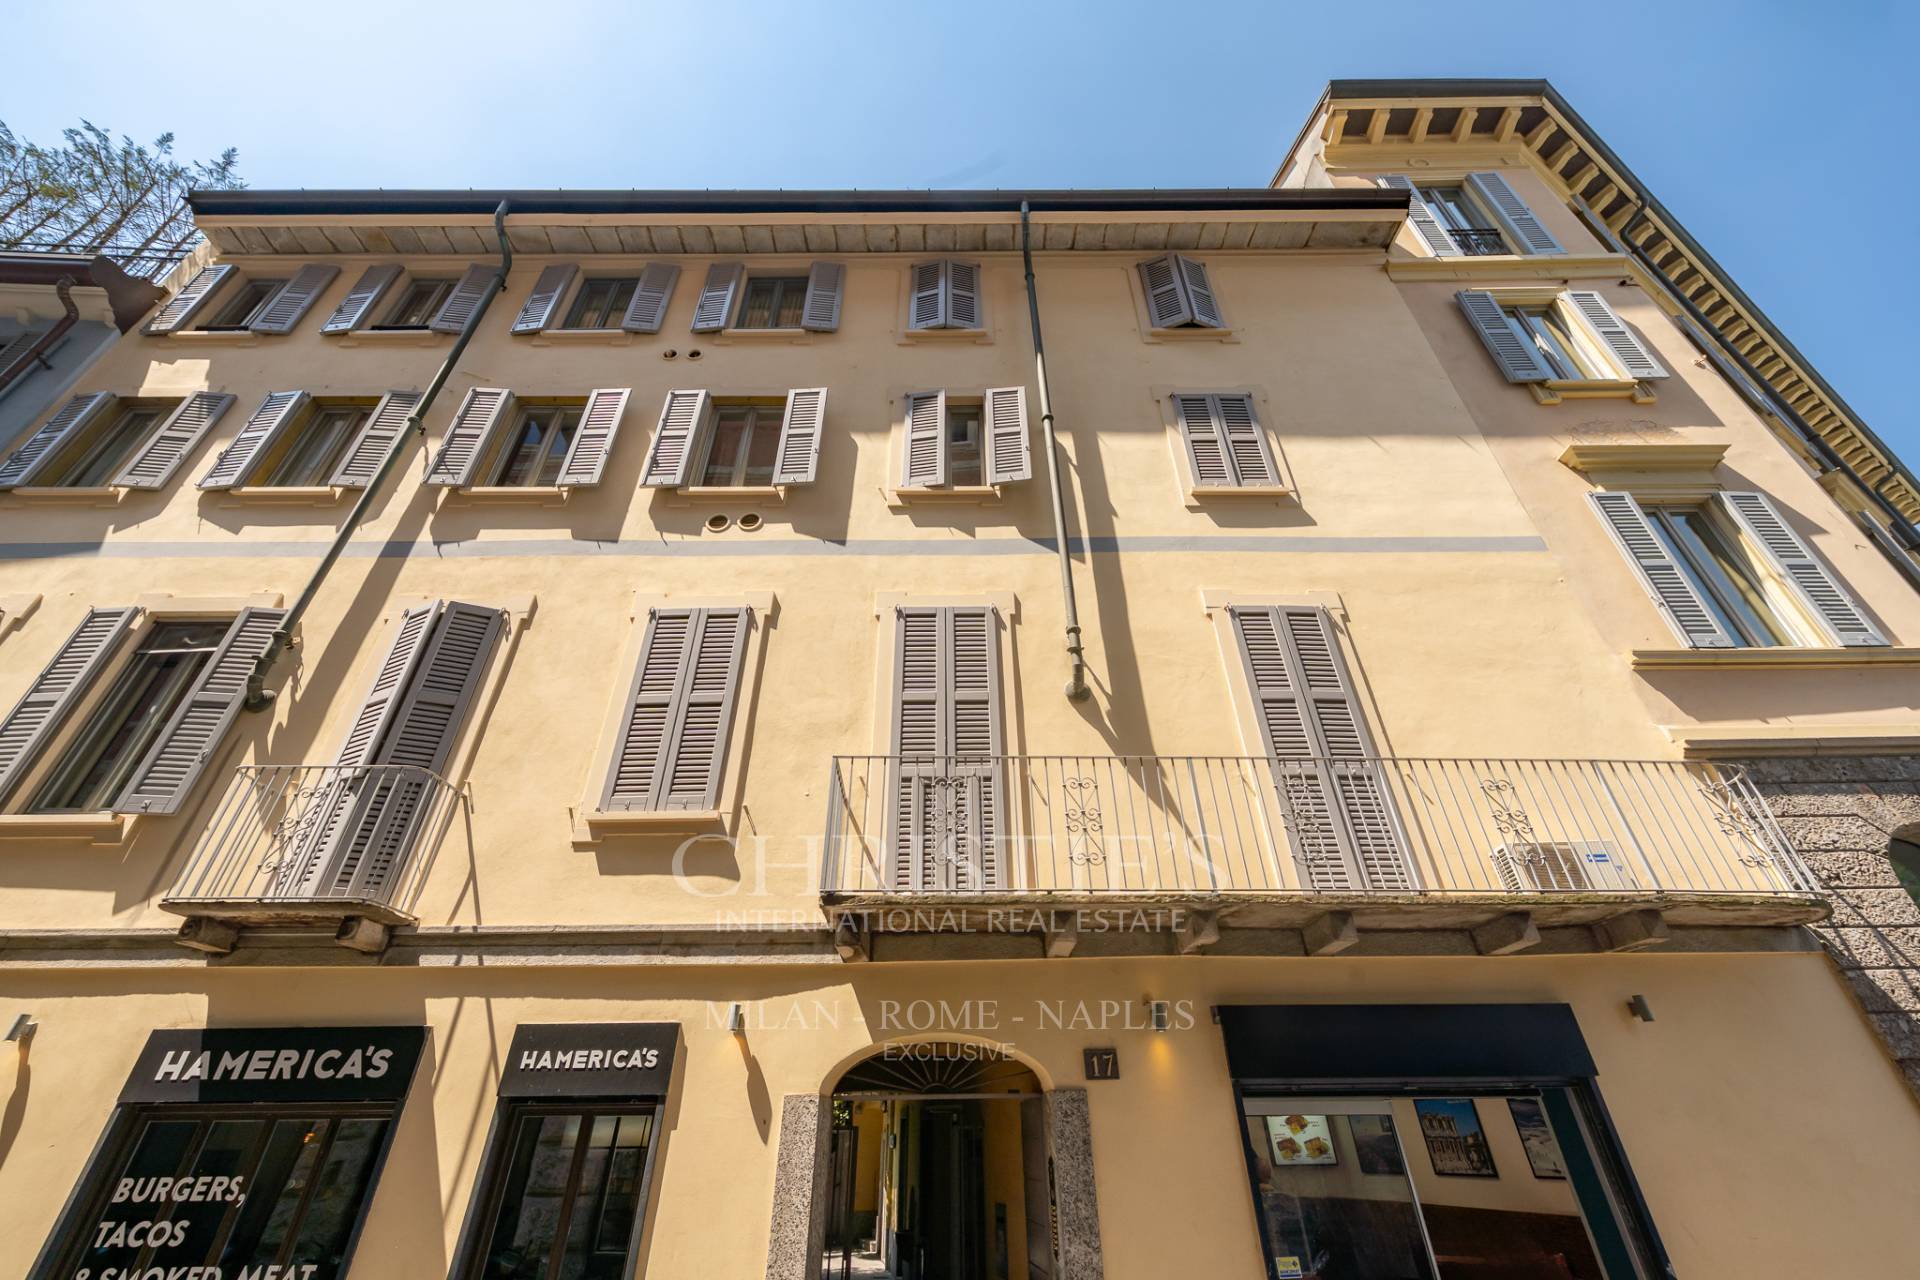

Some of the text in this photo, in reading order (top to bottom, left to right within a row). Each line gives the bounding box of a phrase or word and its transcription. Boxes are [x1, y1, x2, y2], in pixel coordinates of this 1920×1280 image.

[154, 1046, 393, 1081] HAMERICA'S
[519, 1047, 659, 1070] HAMERICA'S
[1091, 1054, 1114, 1077] 17
[111, 1176, 247, 1208] BURGERS,
[94, 1219, 191, 1248] TACOS
